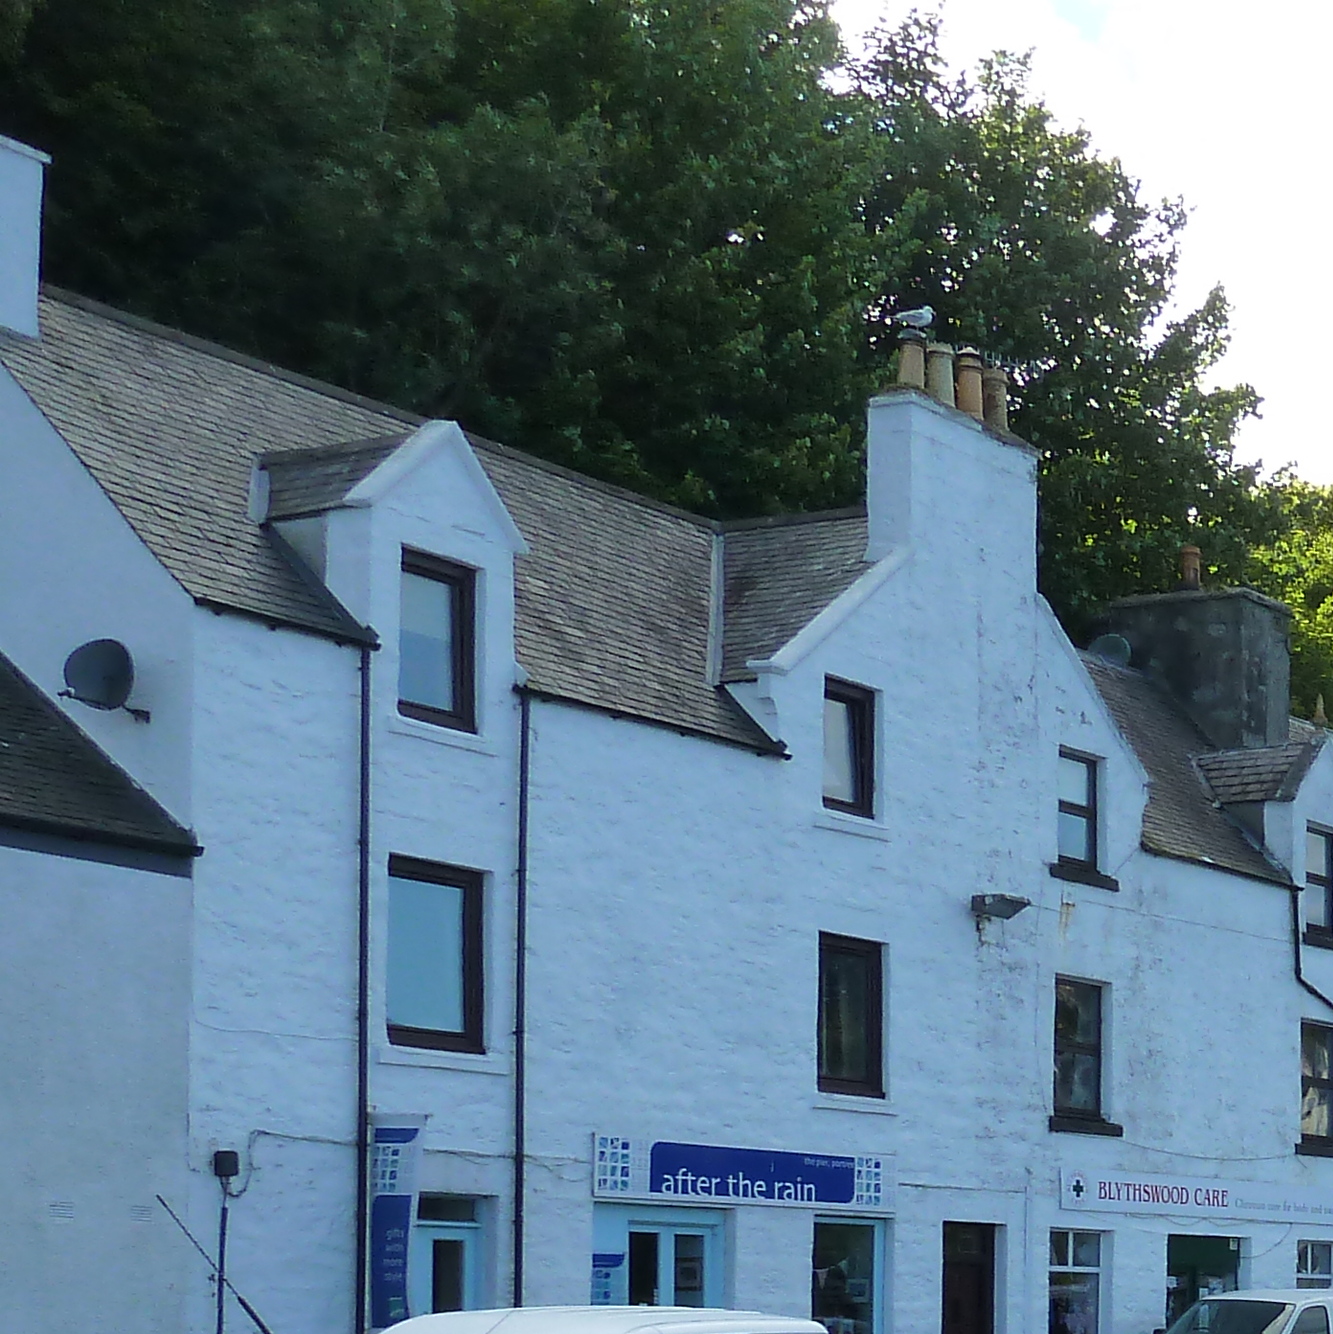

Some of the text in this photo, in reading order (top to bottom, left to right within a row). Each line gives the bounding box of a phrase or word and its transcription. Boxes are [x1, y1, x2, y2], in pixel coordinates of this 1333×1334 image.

[661, 1168, 816, 1202] after the rain
[1098, 1181, 1189, 1206] BLYTHSWOOD
[1194, 1188, 1229, 1208] CARE
